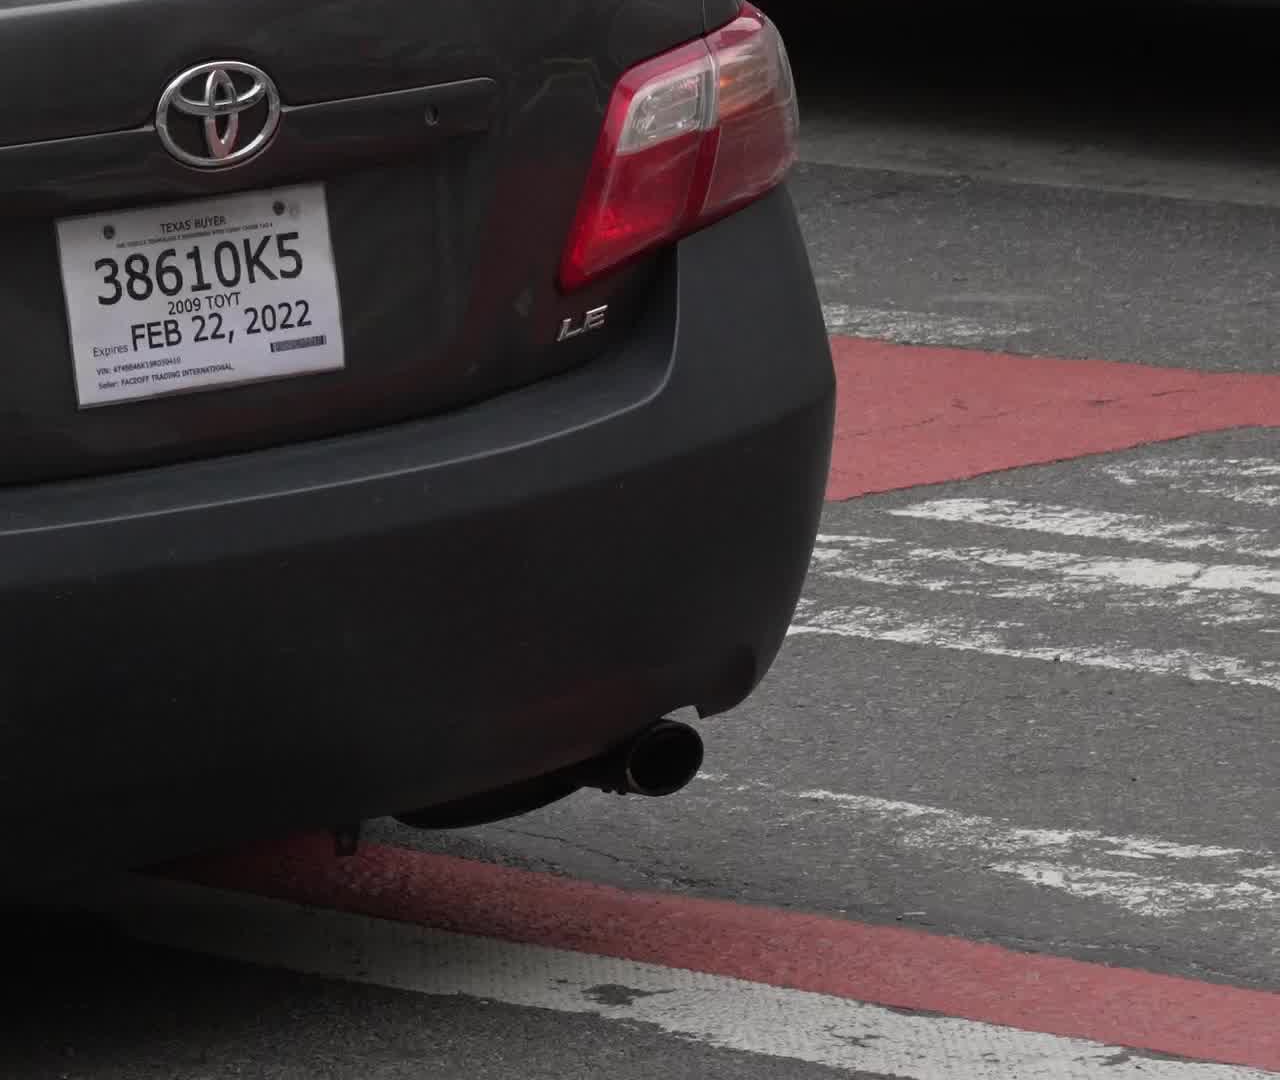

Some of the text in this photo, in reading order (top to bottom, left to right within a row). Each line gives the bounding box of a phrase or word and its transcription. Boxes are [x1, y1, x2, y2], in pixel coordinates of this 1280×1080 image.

[159, 220, 192, 235] TEXAS
[194, 215, 227, 230] BUYER
[93, 231, 304, 306] 38610K5
[167, 291, 241, 316] 2009 TOYT
[555, 303, 609, 342] LE
[92, 299, 313, 358] Expires FEB 22, 2022
